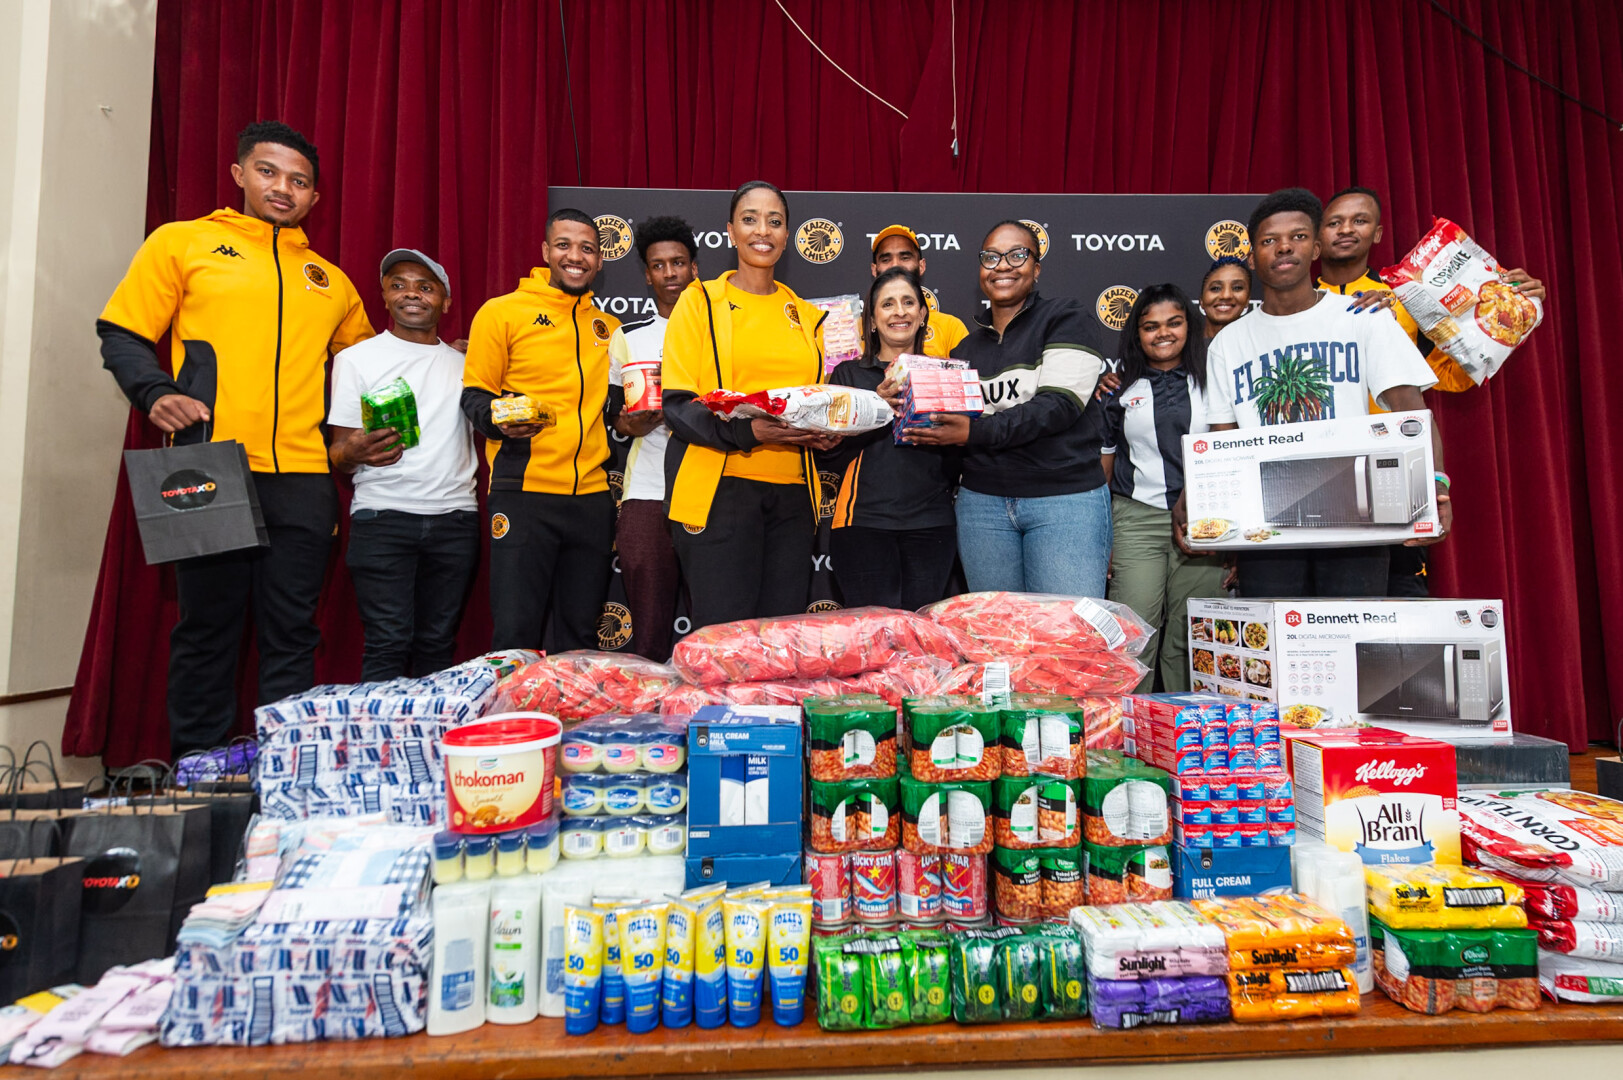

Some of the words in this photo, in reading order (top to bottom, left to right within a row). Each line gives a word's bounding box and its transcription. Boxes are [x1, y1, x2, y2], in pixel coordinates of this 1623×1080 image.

[803, 221, 836, 235] KAIZER
[1213, 223, 1245, 236] KAIZER
[866, 234, 960, 250] TOTA
[1071, 234, 1165, 251] TOYOTA
[803, 248, 836, 261] CHIEFS
[1104, 288, 1136, 301] KAIZER
[1233, 341, 1360, 405] FLAMENCO
[1213, 436, 1264, 450] Bennett
[1268, 432, 1304, 445] Read
[1307, 613, 1359, 624] Bennett
[1363, 612, 1397, 623] Read
[748, 757, 766, 765] MILK
[454, 769, 524, 787] thokoman
[1355, 759, 1425, 786] Kellogg's
[1377, 802, 1402, 824] All
[1367, 820, 1419, 842] Bran
[1514, 815, 1580, 851] CORN
[876, 855, 892, 867] STAR
[951, 854, 969, 868] STAR
[1380, 854, 1410, 863] Flakes
[1192, 877, 1213, 888] FULL
[1216, 875, 1251, 887] CREAM
[1193, 888, 1216, 900] MILK
[859, 902, 889, 912] PILCHARDS
[568, 954, 584, 971] 50
[634, 953, 654, 969] 50
[666, 948, 680, 965] 50
[735, 948, 754, 965] 50
[780, 947, 799, 962] 50
[1251, 948, 1298, 965] Sunlight
[1119, 956, 1167, 972] Sunlight
[1236, 971, 1270, 986] Sunlight
